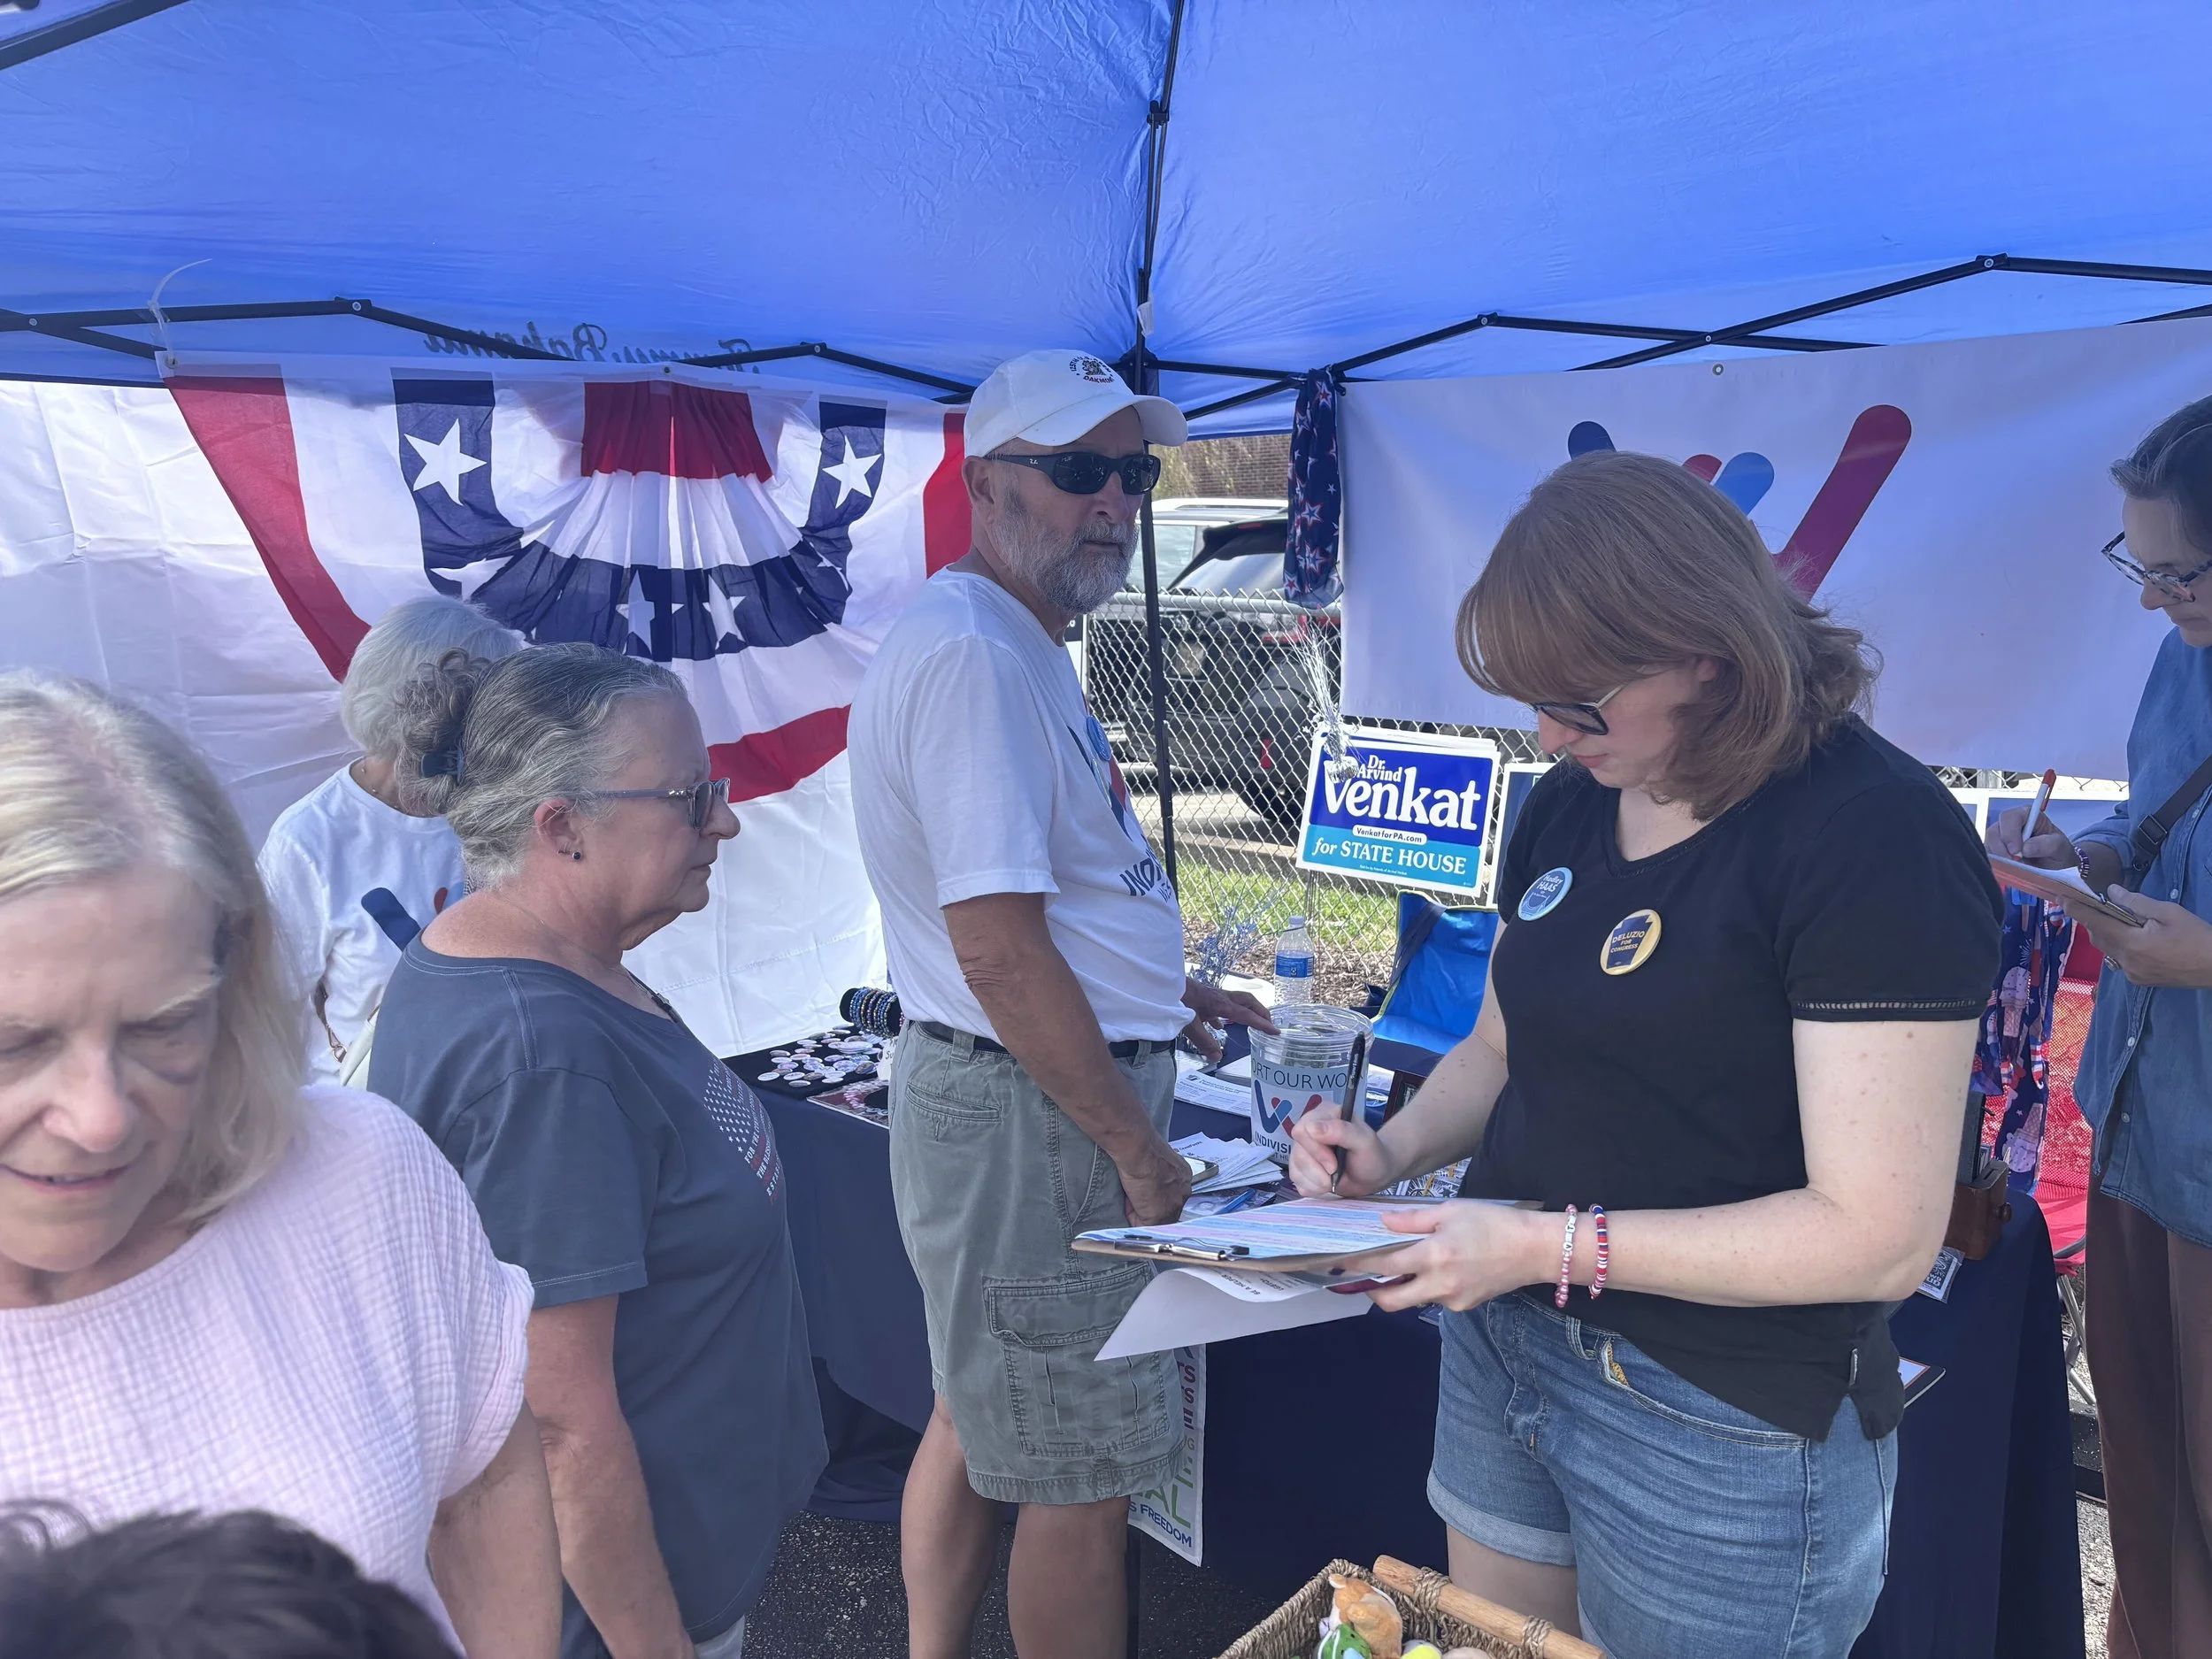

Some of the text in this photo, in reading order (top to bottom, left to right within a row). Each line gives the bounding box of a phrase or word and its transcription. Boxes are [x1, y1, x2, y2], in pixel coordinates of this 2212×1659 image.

[1367, 754, 1386, 769] Dr.
[1356, 764, 1403, 783] Arvind
[1323, 756, 1482, 832] Venkat
[1311, 837, 1337, 856] for
[1340, 840, 1394, 864] STATE
[1397, 849, 1468, 875] HOUSE
[1536, 881, 1558, 893] HAAS
[1611, 931, 1645, 944] DELUZIO
[1610, 943, 1639, 954] CONGRESS
[1274, 1070, 1313, 1089] OUR
[1317, 1072, 1363, 1089] WO
[1255, 1130, 1291, 1155] INDIVISI
[1140, 1503, 1193, 1548] FREEDOM
